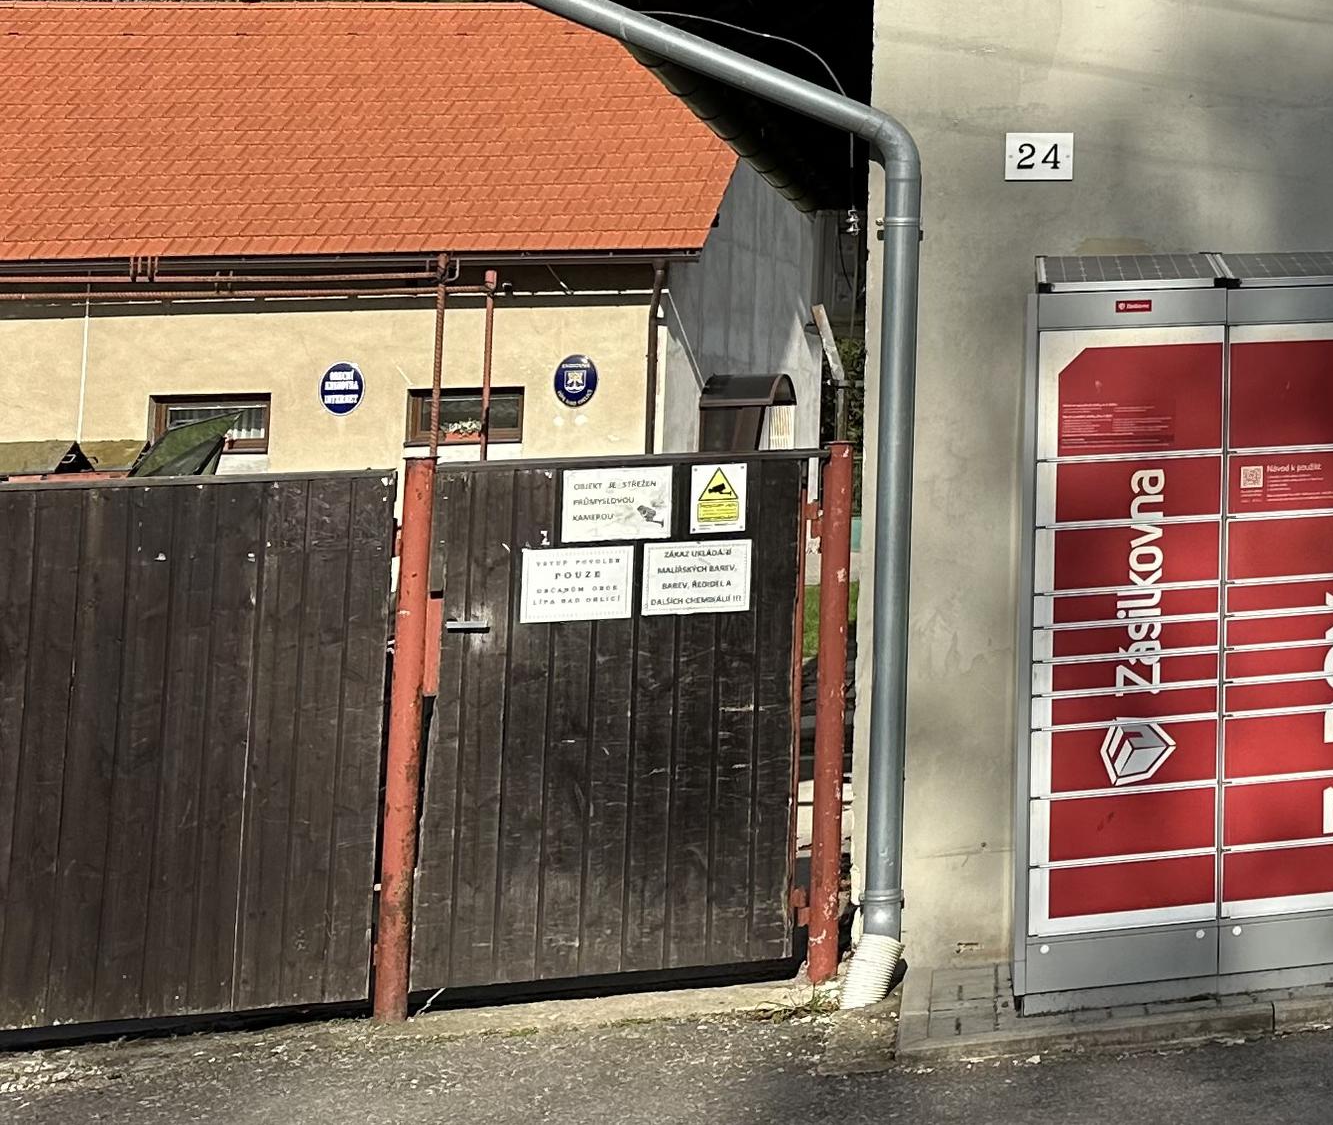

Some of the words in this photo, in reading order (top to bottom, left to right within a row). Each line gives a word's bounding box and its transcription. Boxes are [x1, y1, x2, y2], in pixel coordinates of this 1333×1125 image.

[1016, 142, 1061, 170] 24
[573, 482, 602, 491] OBJEKT
[608, 481, 617, 489] JE
[572, 513, 615, 522] KAMEROU
[664, 549, 690, 558] ZÁKAZ
[536, 559, 568, 567] VSTUP
[575, 557, 621, 565] POVOLEN
[554, 570, 601, 580] POUZE
[726, 579, 732, 587] A
[1115, 468, 1166, 697] Zásilkovna
